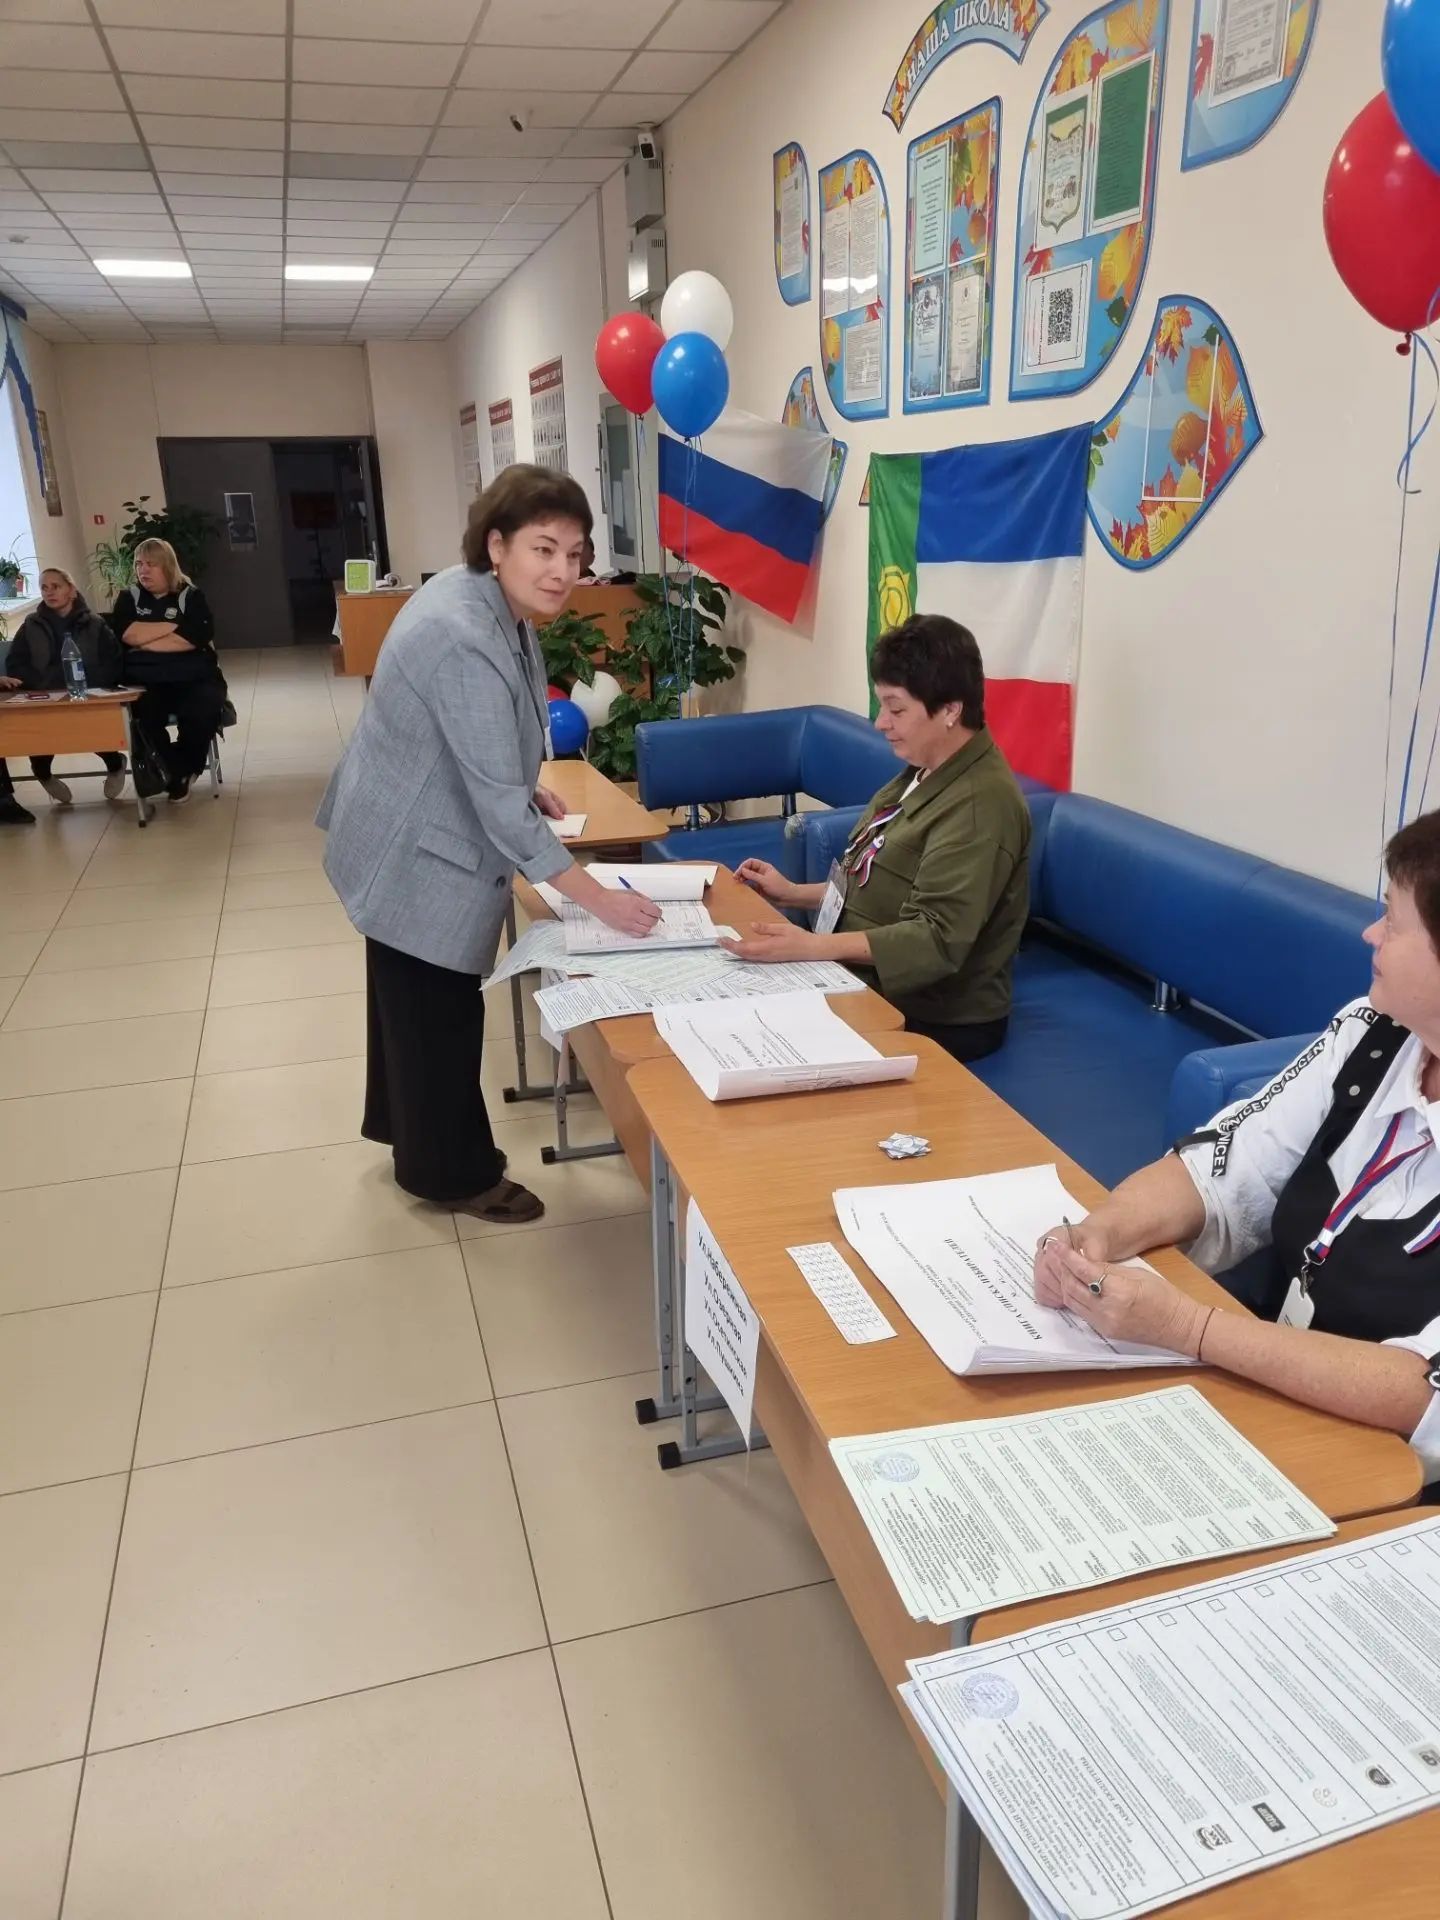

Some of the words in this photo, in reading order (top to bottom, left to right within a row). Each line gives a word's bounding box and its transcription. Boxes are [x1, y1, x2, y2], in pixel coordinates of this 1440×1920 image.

[906, 19, 950, 88] НАША
[953, 0, 1010, 33] ШКОЛА
[944, 1238, 991, 1284] ИЗБИРАТЕЛЕЙ
[988, 1284, 1018, 1313] СПИСКА
[1016, 1313, 1042, 1340] КНИГА
